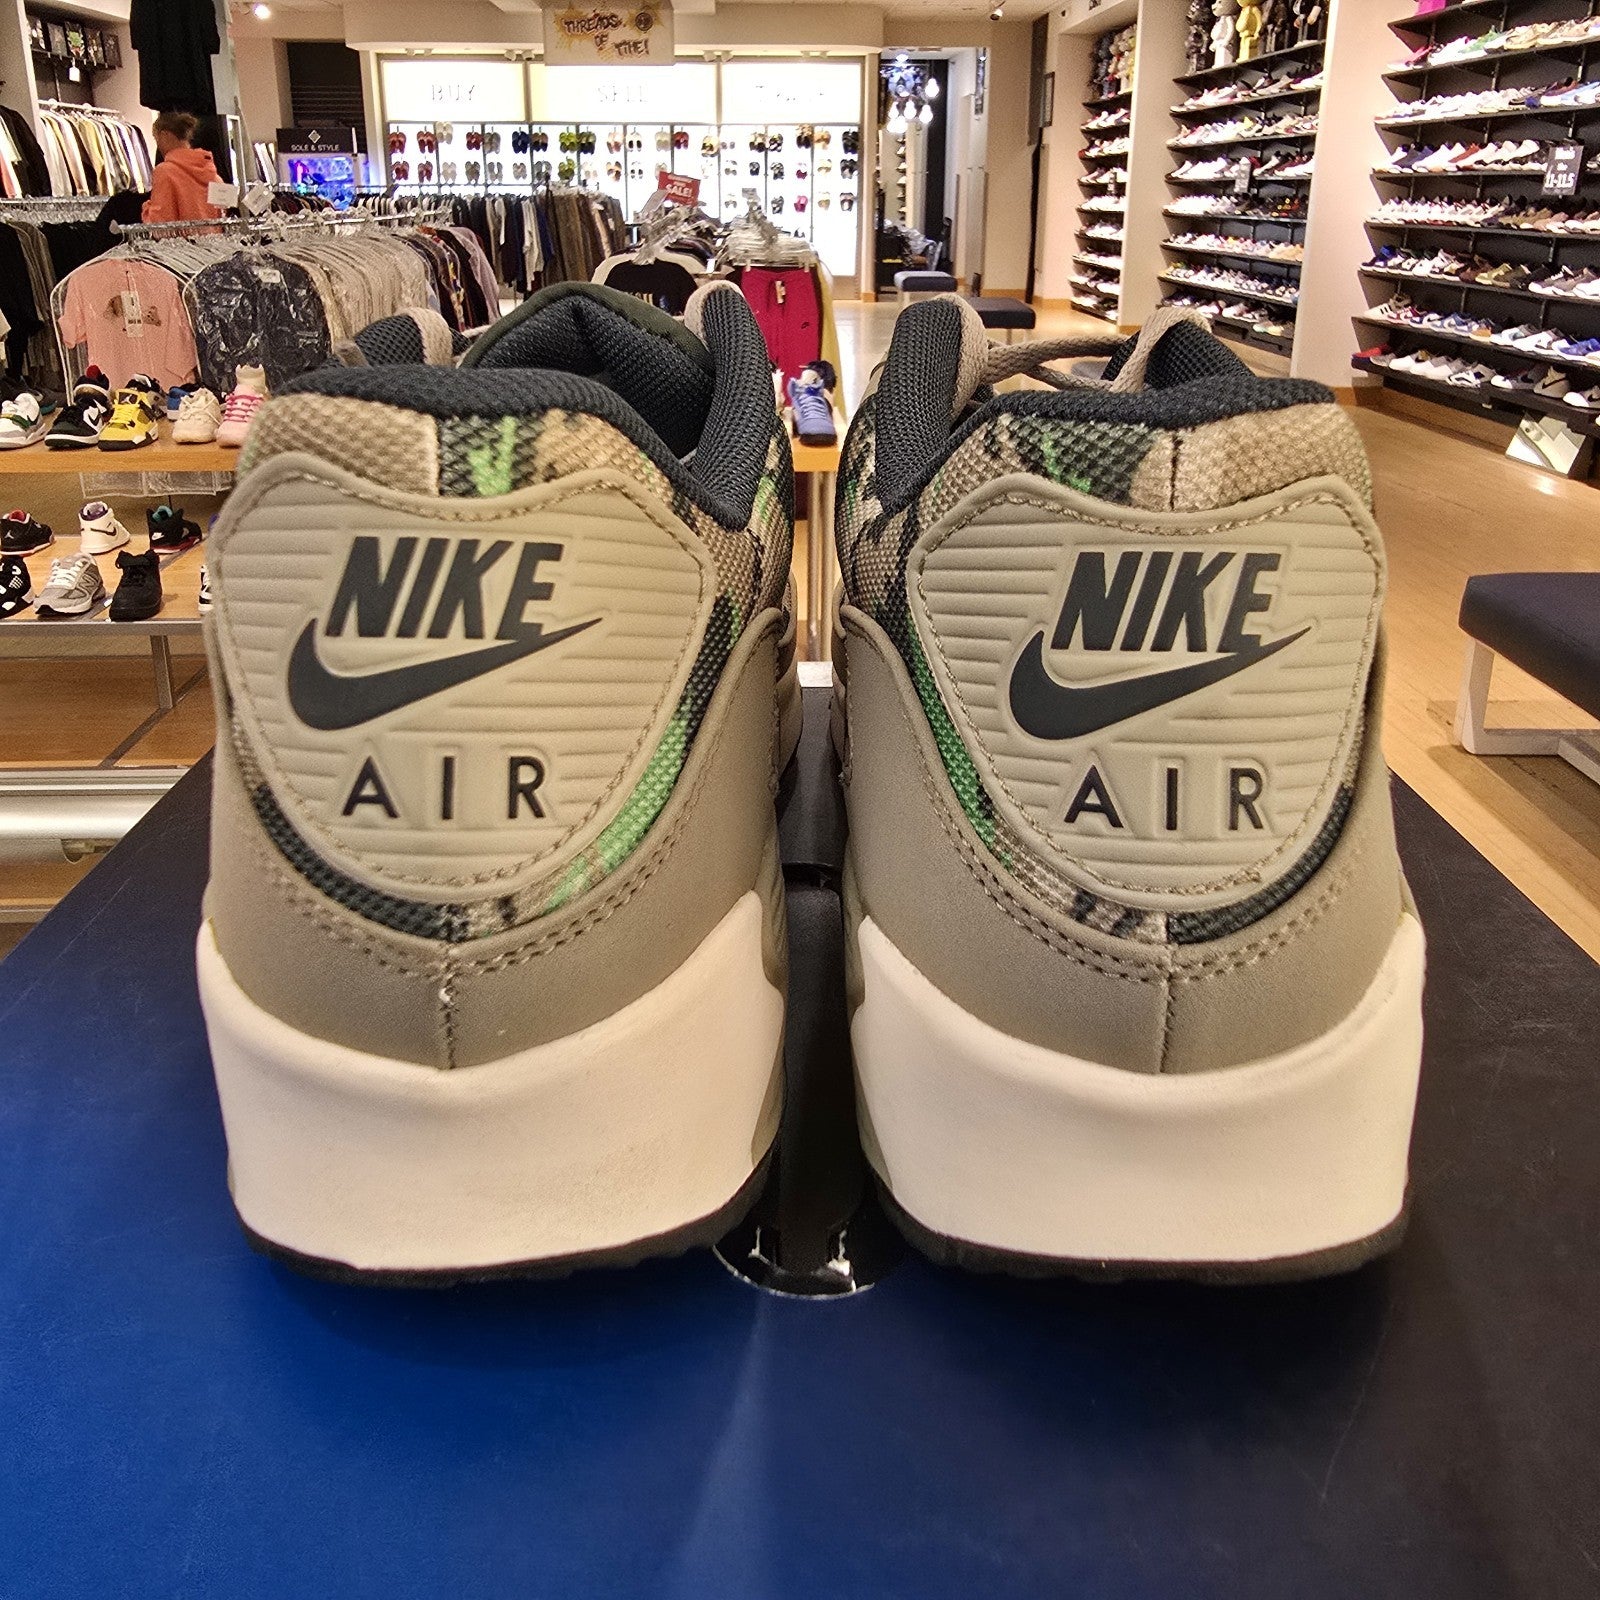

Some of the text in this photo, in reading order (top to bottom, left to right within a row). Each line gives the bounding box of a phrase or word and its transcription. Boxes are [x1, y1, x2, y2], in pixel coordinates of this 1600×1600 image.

[431, 84, 475, 101] BUY
[291, 144, 309, 152] SOLE
[317, 144, 340, 152] STYLE
[325, 535, 565, 641] NIKE
[1050, 550, 1282, 654] NIKE
[341, 755, 547, 821] AIR
[1063, 764, 1264, 831] AIR
